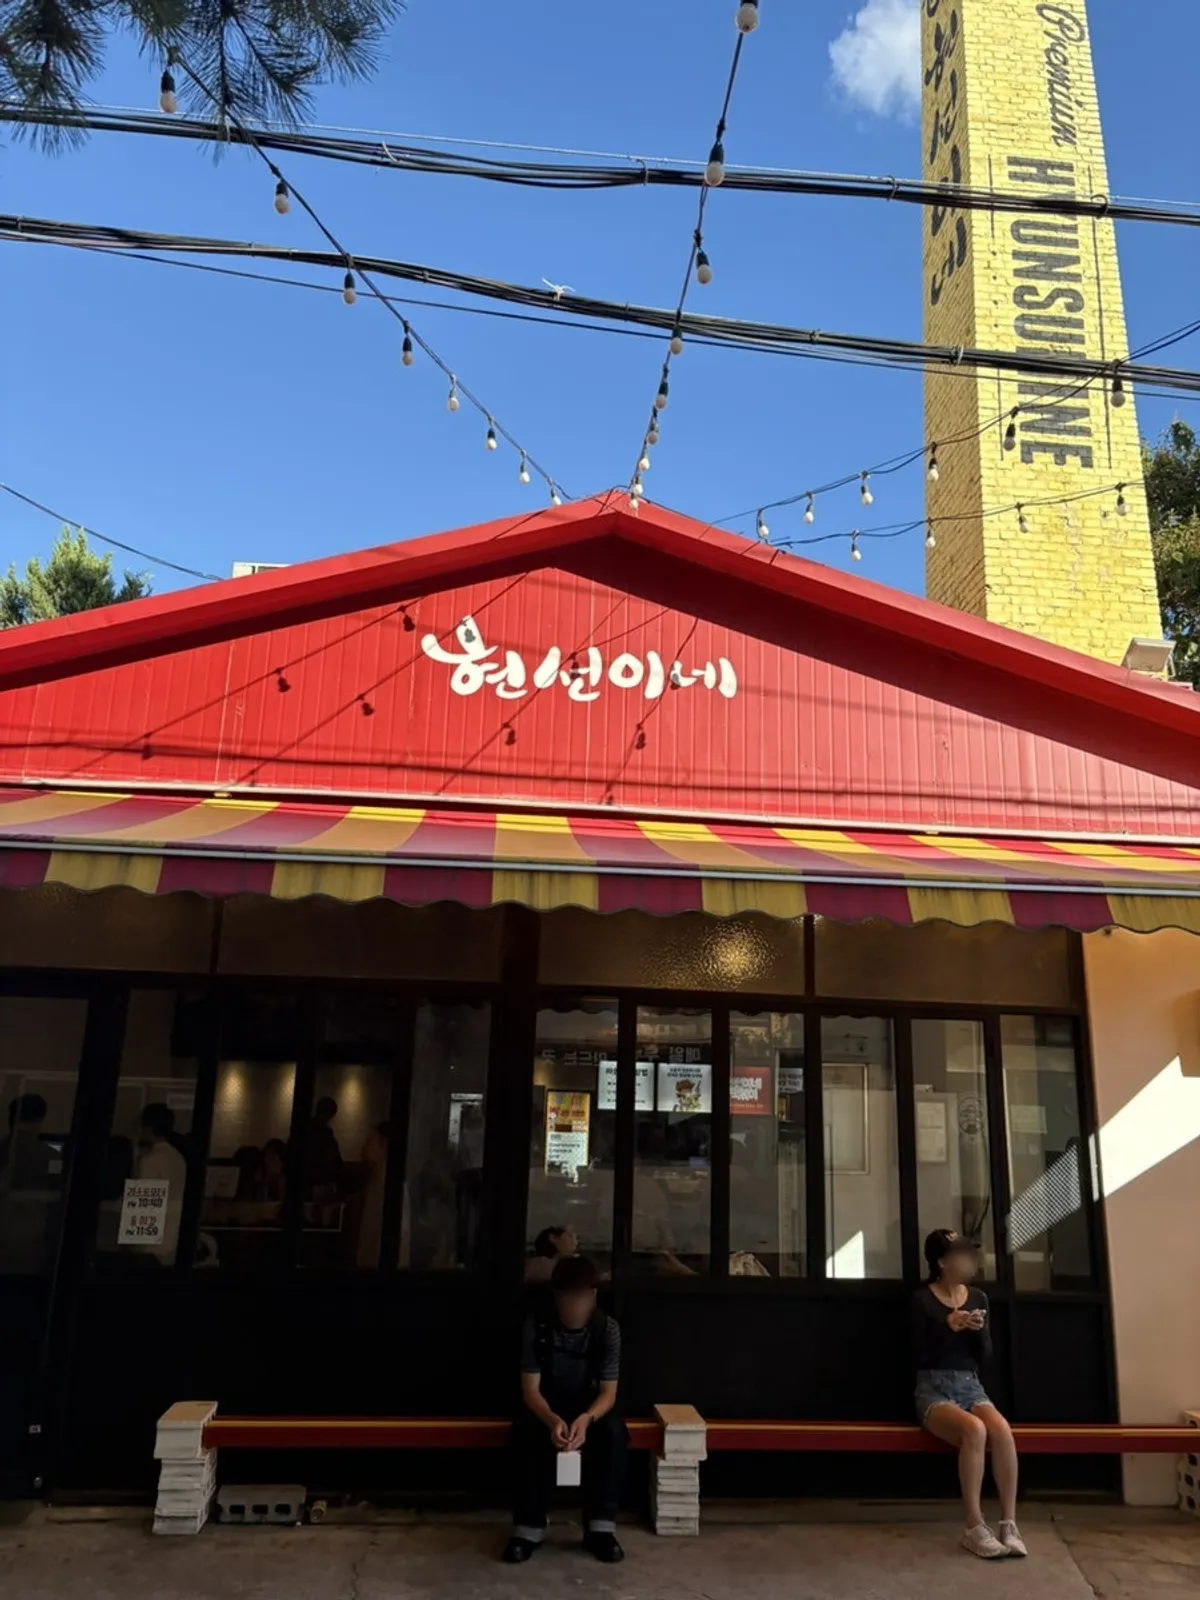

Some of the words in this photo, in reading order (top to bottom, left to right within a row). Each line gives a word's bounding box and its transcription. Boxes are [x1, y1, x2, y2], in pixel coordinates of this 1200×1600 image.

[1035, 3, 1086, 148] Premium
[1006, 155, 1093, 469] HUNSUINE
[420, 614, 738, 702] 현선이네
